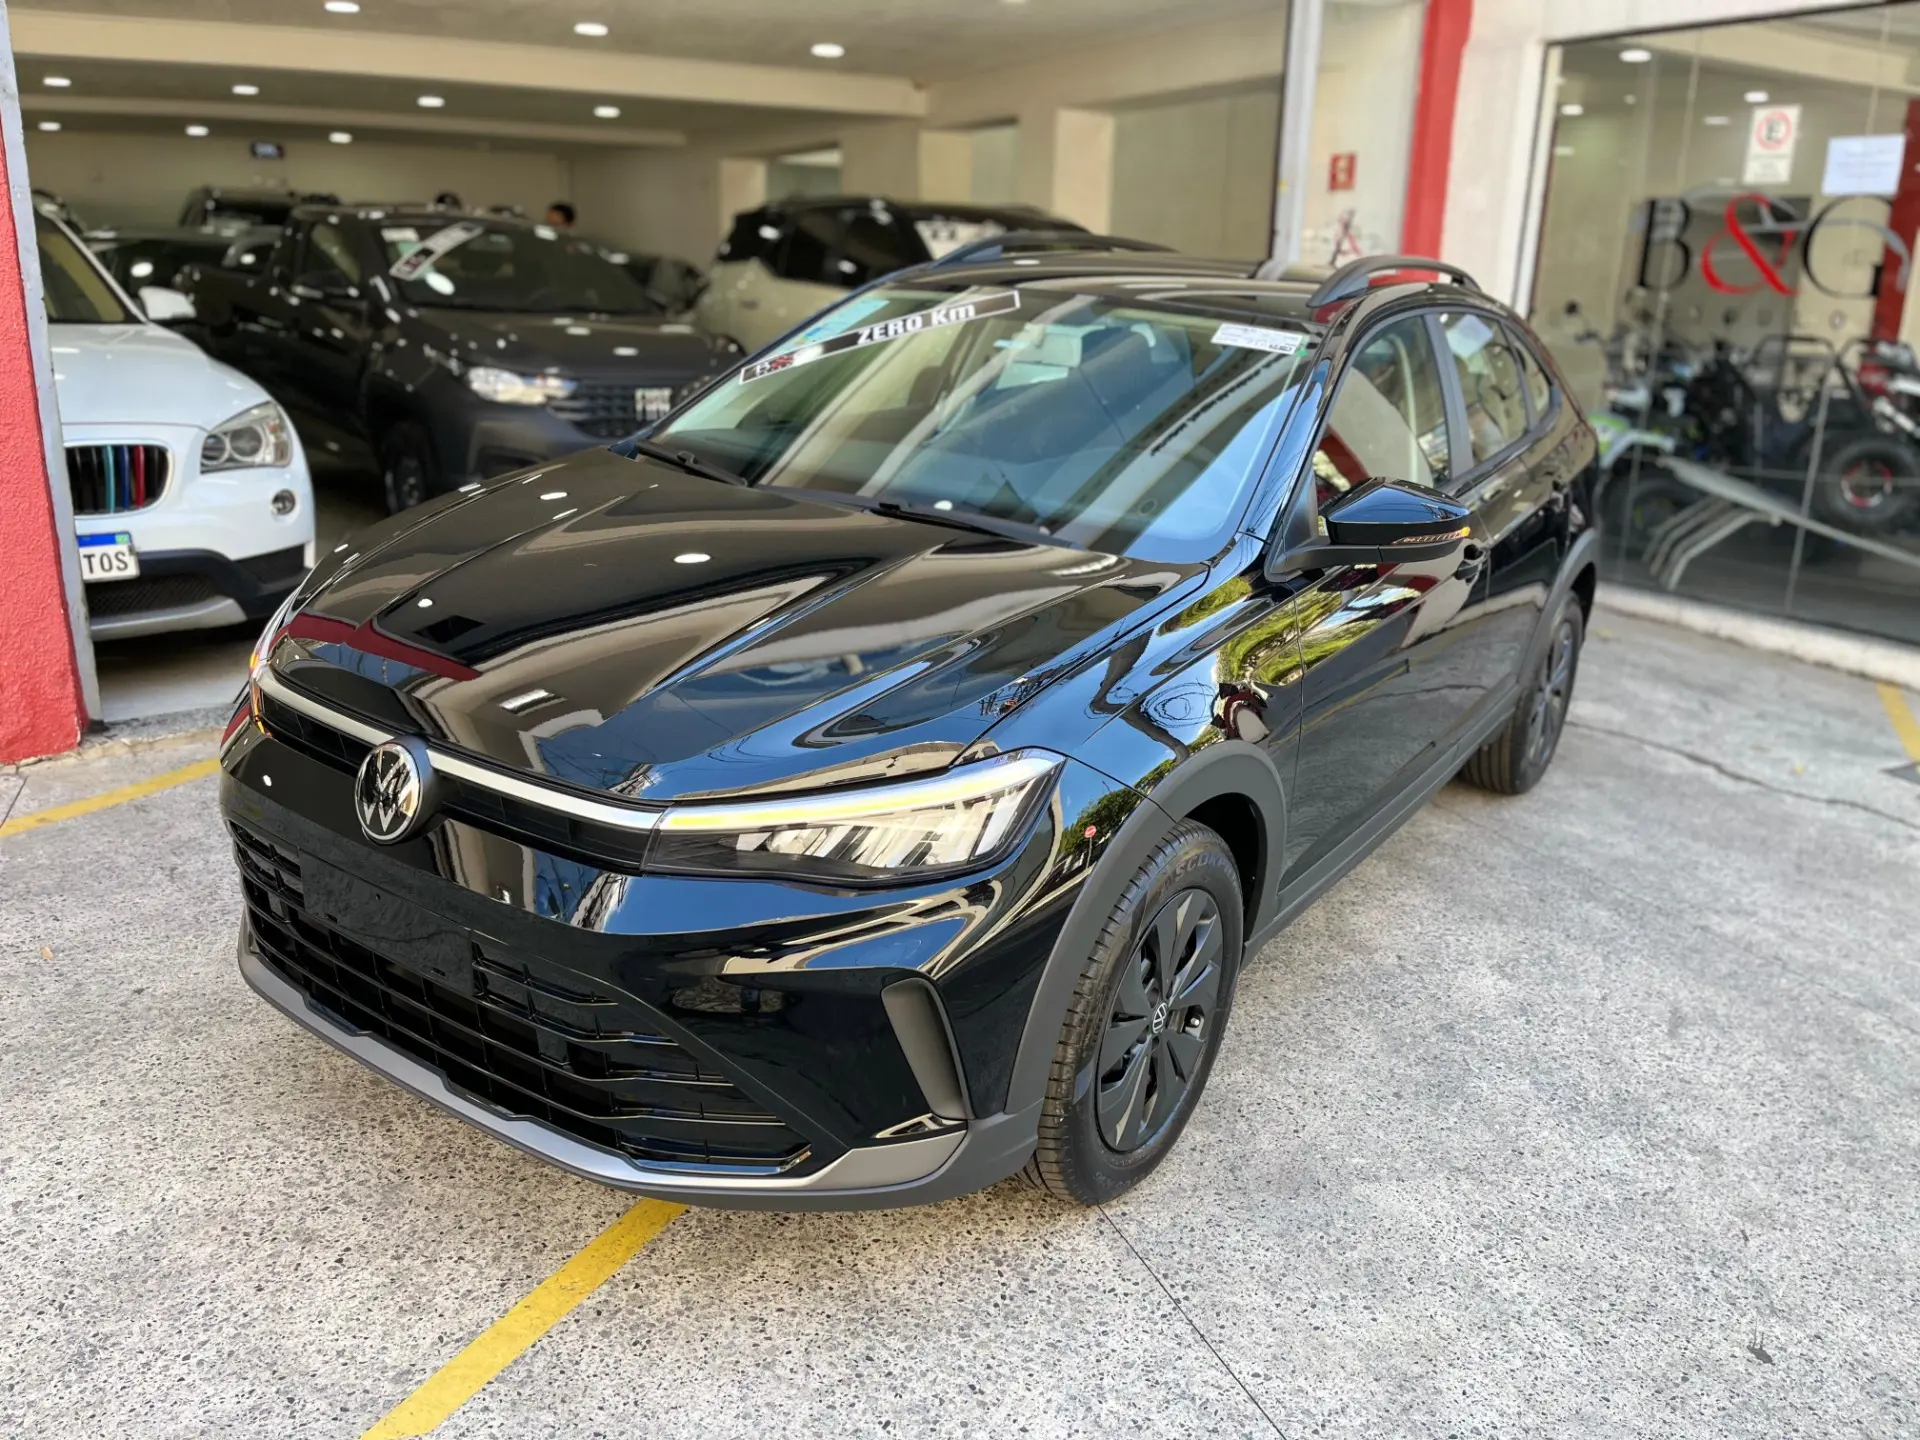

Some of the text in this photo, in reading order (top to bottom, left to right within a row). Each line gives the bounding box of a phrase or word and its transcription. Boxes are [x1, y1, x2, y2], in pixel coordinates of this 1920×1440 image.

[1638, 191, 1889, 298] B&G
[858, 315, 922, 345] ZERO
[932, 304, 976, 328] Km
